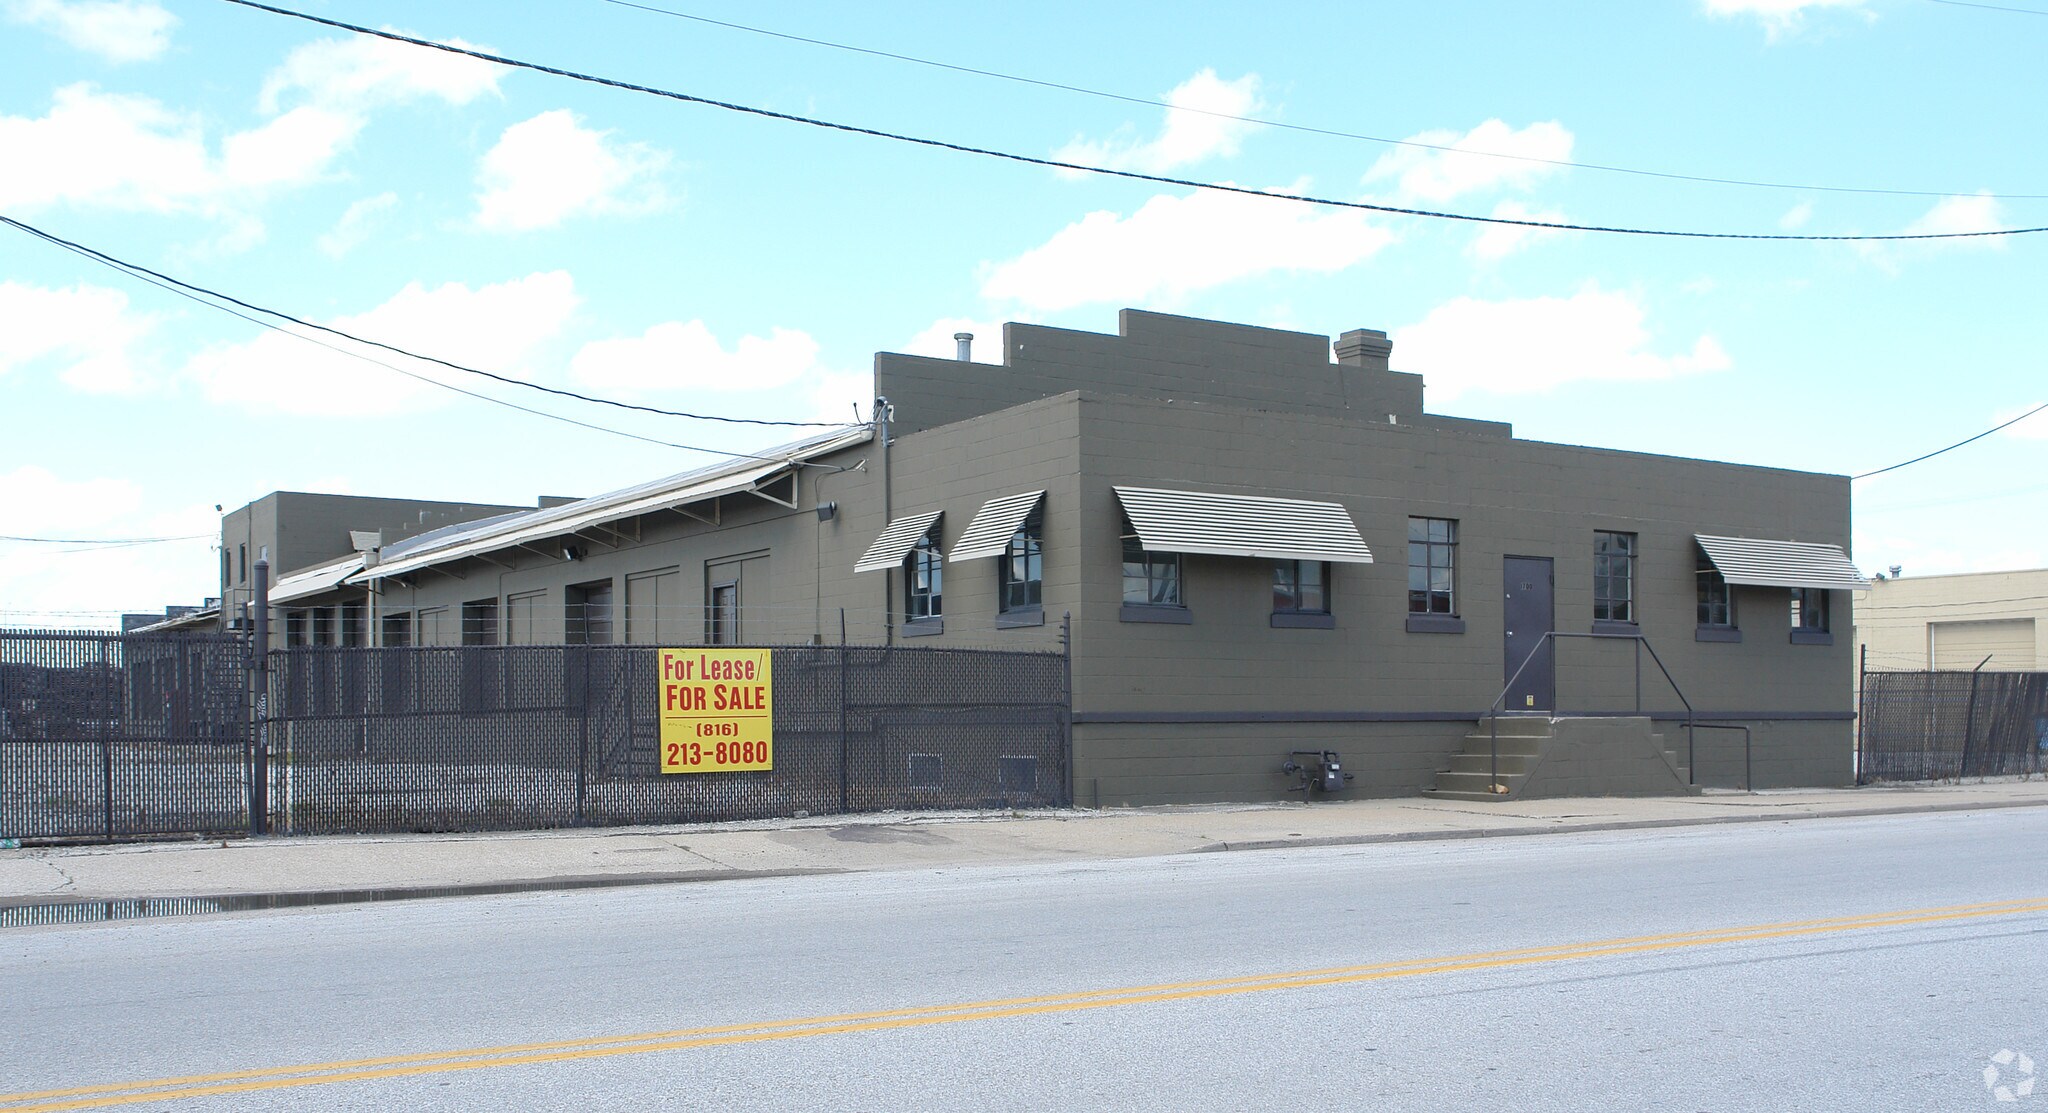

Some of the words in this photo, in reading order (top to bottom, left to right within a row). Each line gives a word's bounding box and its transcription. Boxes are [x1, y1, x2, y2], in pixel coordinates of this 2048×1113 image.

[664, 654, 694, 680] For
[666, 685, 707, 711] FOR
[713, 684, 766, 710] SALE
[696, 722, 739, 737] (816)
[667, 741, 768, 766] 213-8080
